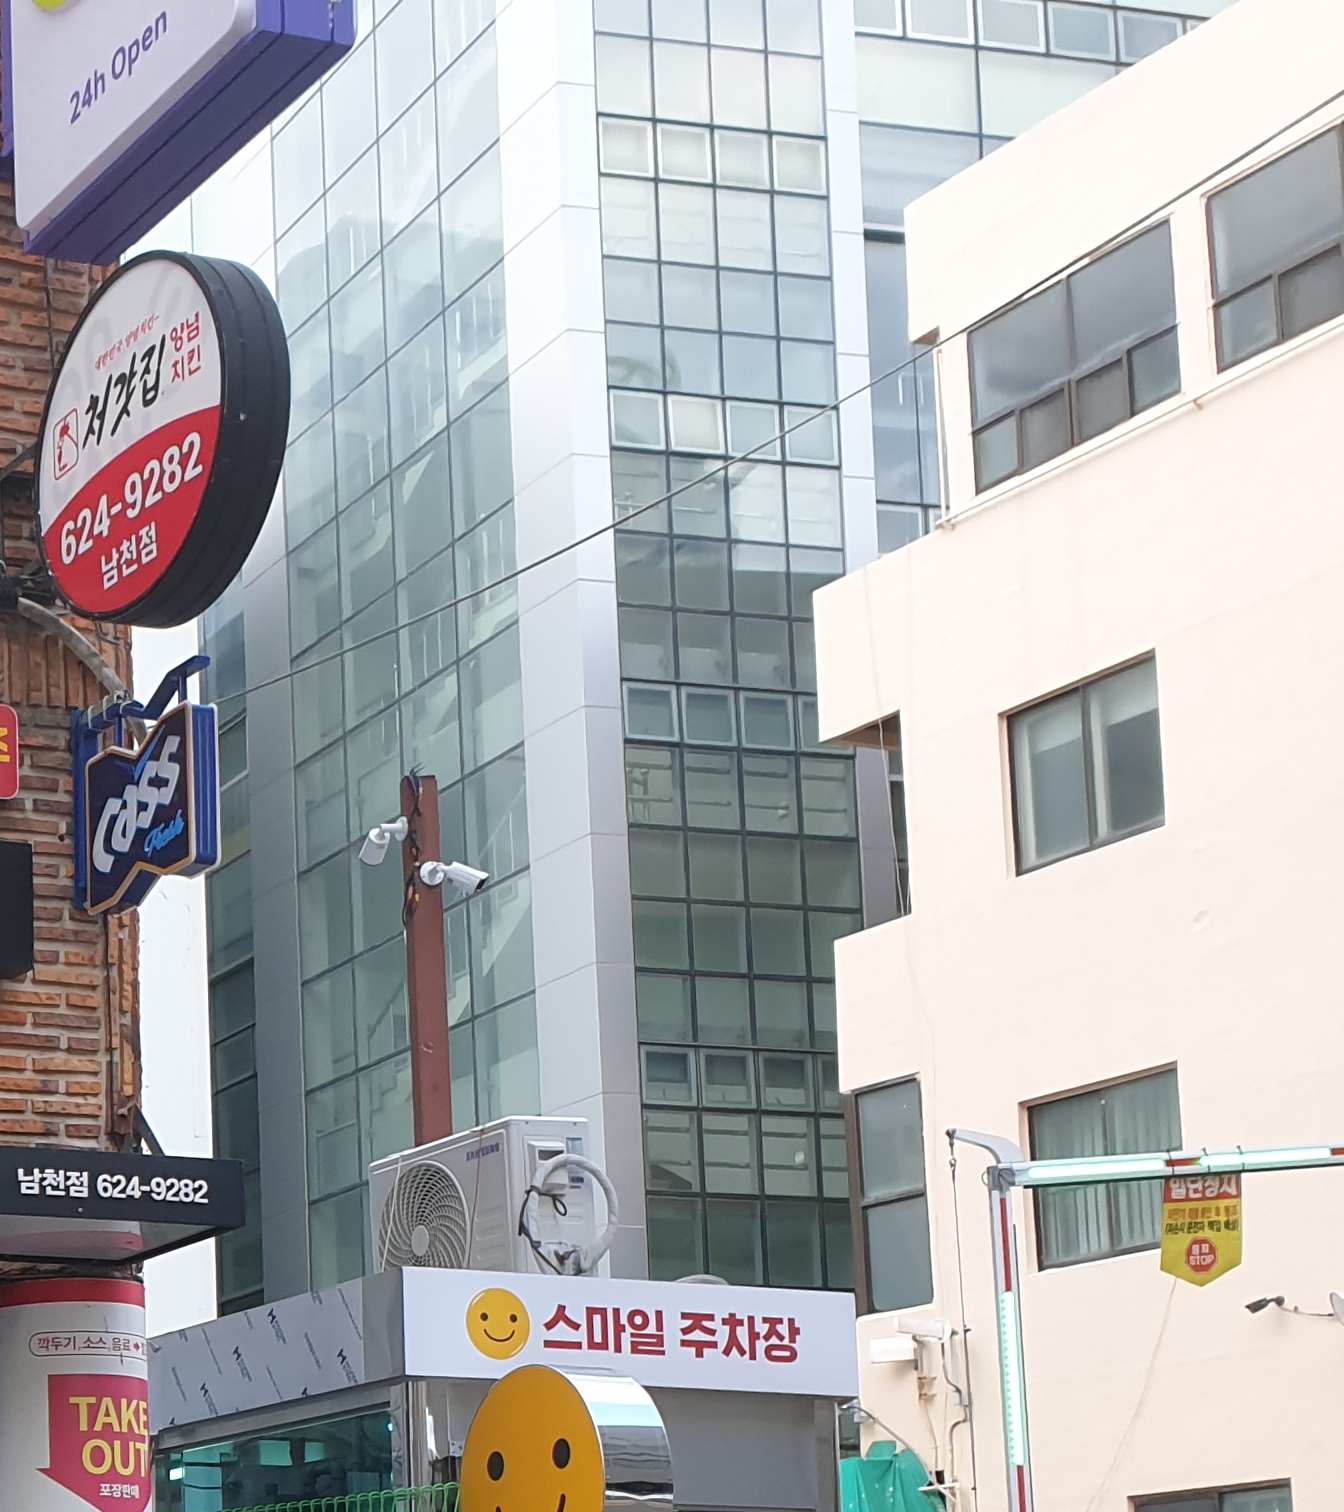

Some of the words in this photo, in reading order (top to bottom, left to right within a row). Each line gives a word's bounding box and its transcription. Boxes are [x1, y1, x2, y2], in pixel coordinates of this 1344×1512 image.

[69, 67, 106, 126] 24h
[111, 11, 169, 81] Open
[170, 310, 200, 352] 양념
[171, 344, 202, 383] 치킨
[82, 333, 166, 450] 처갓집
[60, 431, 203, 565] 624-9282
[101, 522, 159, 590] 남천점
[92, 734, 181, 873] Cass
[466, 1143, 500, 1161] SAMSUNG
[17, 1168, 89, 1198] 남천점
[97, 1174, 209, 1204] 624-9282
[1189, 1254, 1214, 1265] STOP
[542, 1304, 667, 1357] 스마일
[679, 1312, 802, 1365] 주차장
[69, 1397, 148, 1436] TAKE
[82, 1439, 147, 1477] OUT
